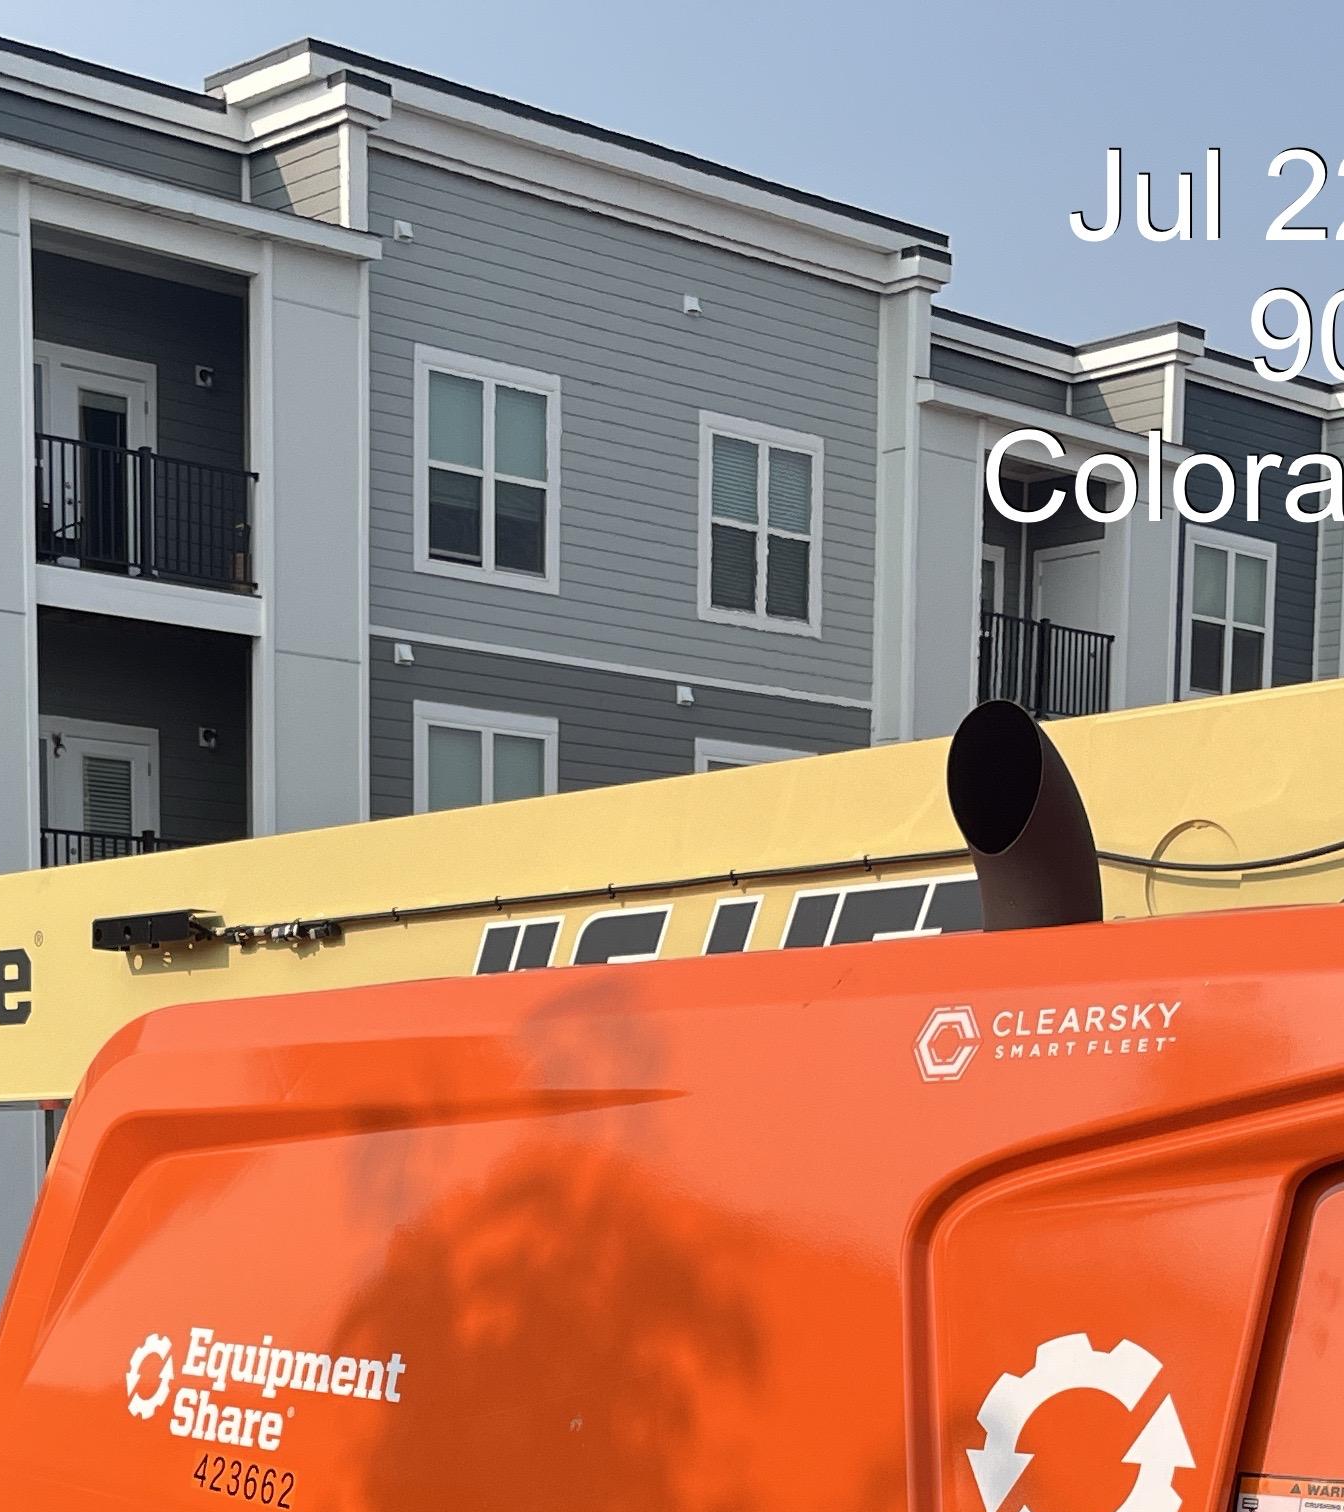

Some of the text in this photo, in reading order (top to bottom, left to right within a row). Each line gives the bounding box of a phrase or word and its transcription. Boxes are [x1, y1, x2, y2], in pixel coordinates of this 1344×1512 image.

[991, 1001, 1182, 1038] CLEARSKY
[994, 1037, 1170, 1060] SMART FLEET
[181, 1327, 407, 1403] Equipment
[169, 1387, 284, 1451] Share
[193, 1453, 296, 1510] 423662
